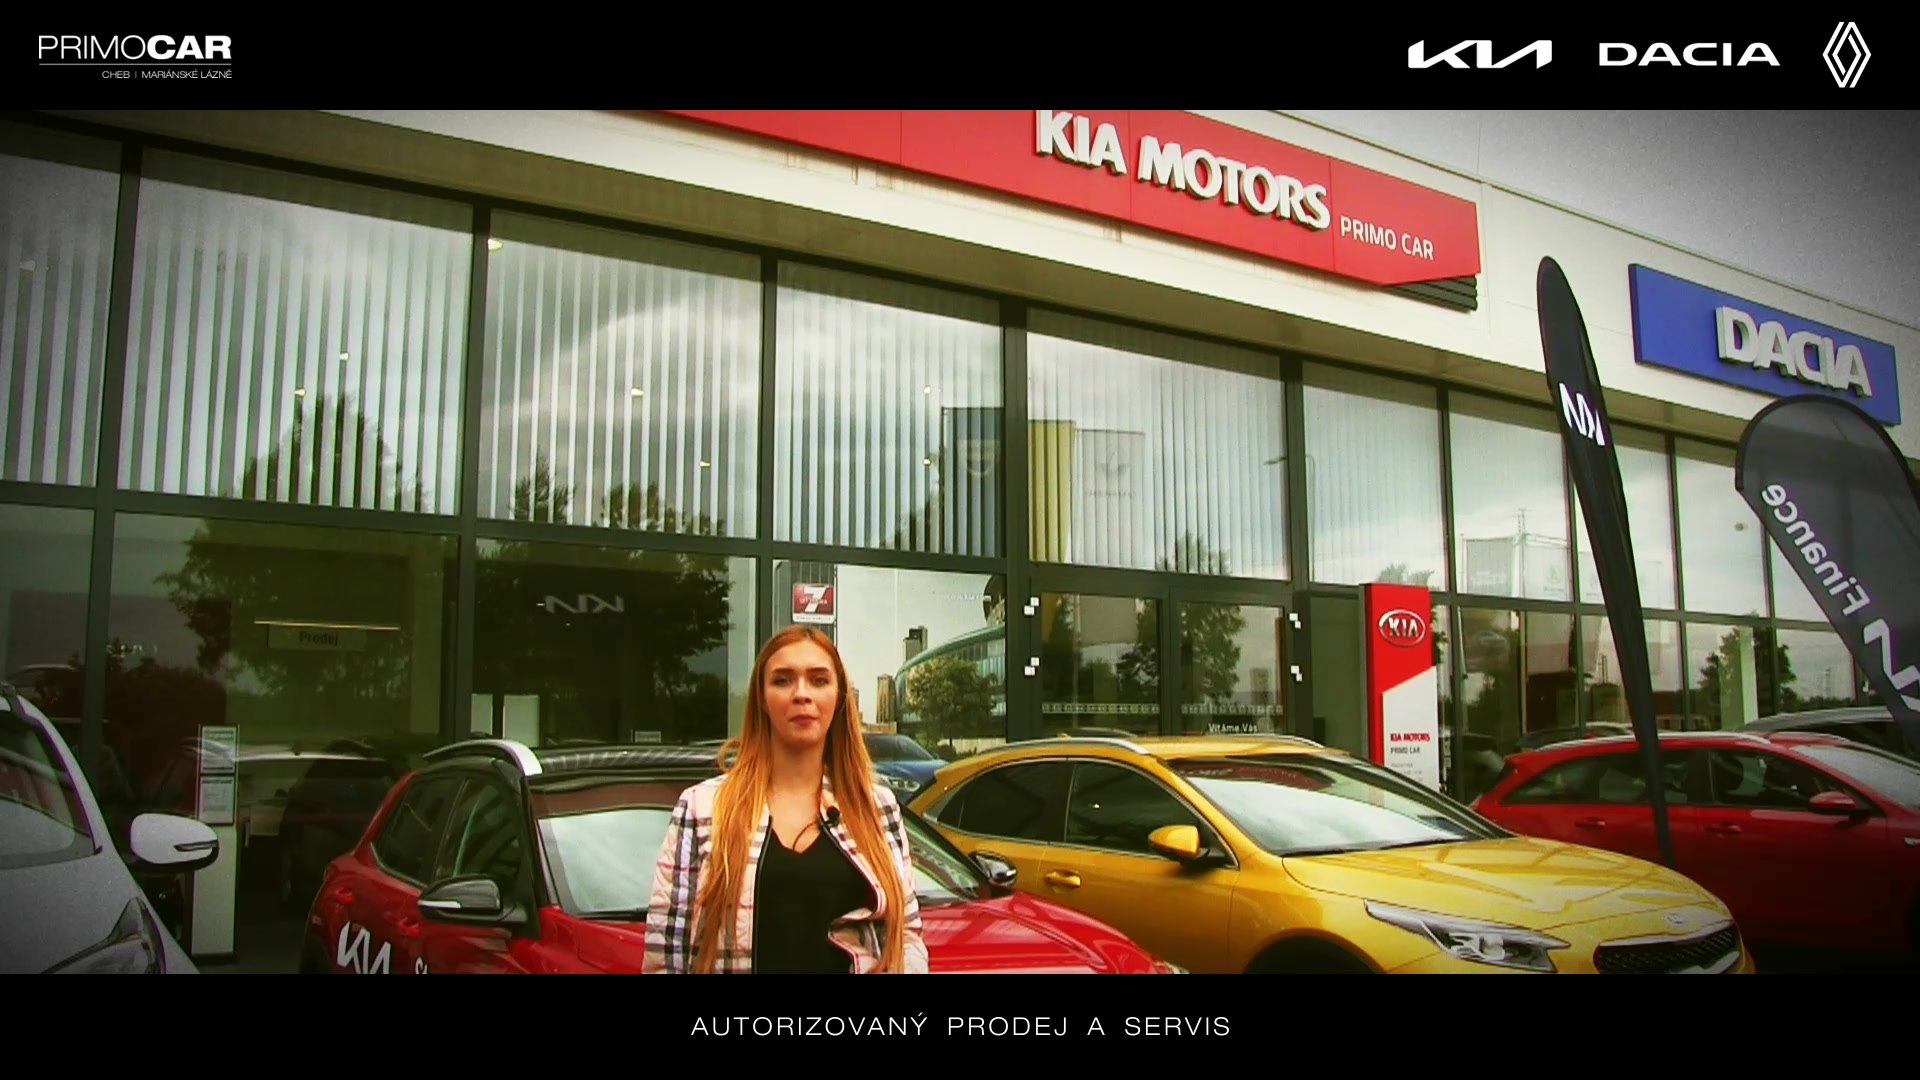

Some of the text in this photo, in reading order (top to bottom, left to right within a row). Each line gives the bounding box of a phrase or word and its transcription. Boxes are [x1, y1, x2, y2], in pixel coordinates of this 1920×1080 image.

[1036, 110, 1331, 231] KIA MOTORS
[1340, 215, 1434, 261] PRIMO CAR
[1715, 305, 1873, 398] DACIA
[299, 630, 339, 646] Prodej
[1388, 616, 1419, 638] KIA
[1390, 732, 1431, 742] KIA MOTORS
